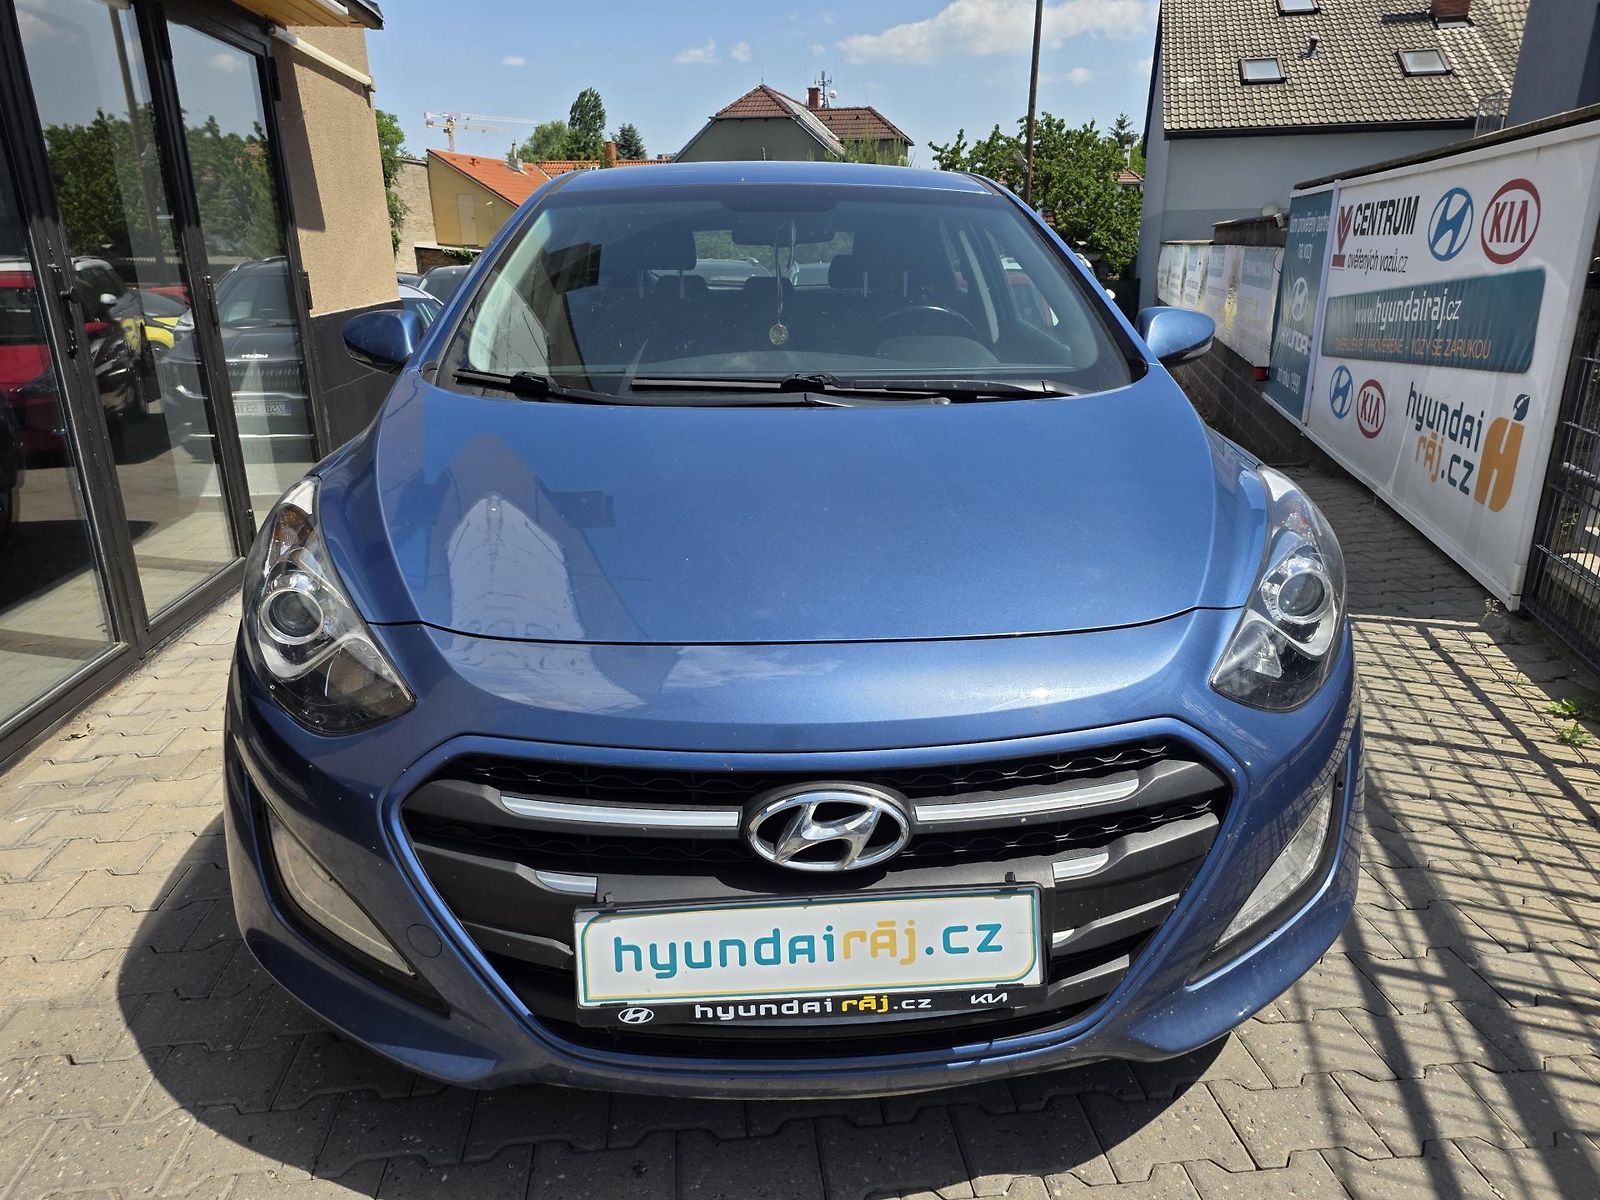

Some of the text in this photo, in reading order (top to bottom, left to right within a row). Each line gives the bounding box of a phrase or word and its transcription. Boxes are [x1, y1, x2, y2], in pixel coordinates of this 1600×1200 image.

[1352, 195, 1420, 237] CENTRUM
[1488, 200, 1530, 244] KIA
[1355, 287, 1463, 331] www.hyundairaj.cz
[1431, 338, 1443, 356] SE
[1361, 388, 1380, 429] KIA
[1406, 381, 1485, 453] hyundai
[694, 997, 834, 1021] hyundai
